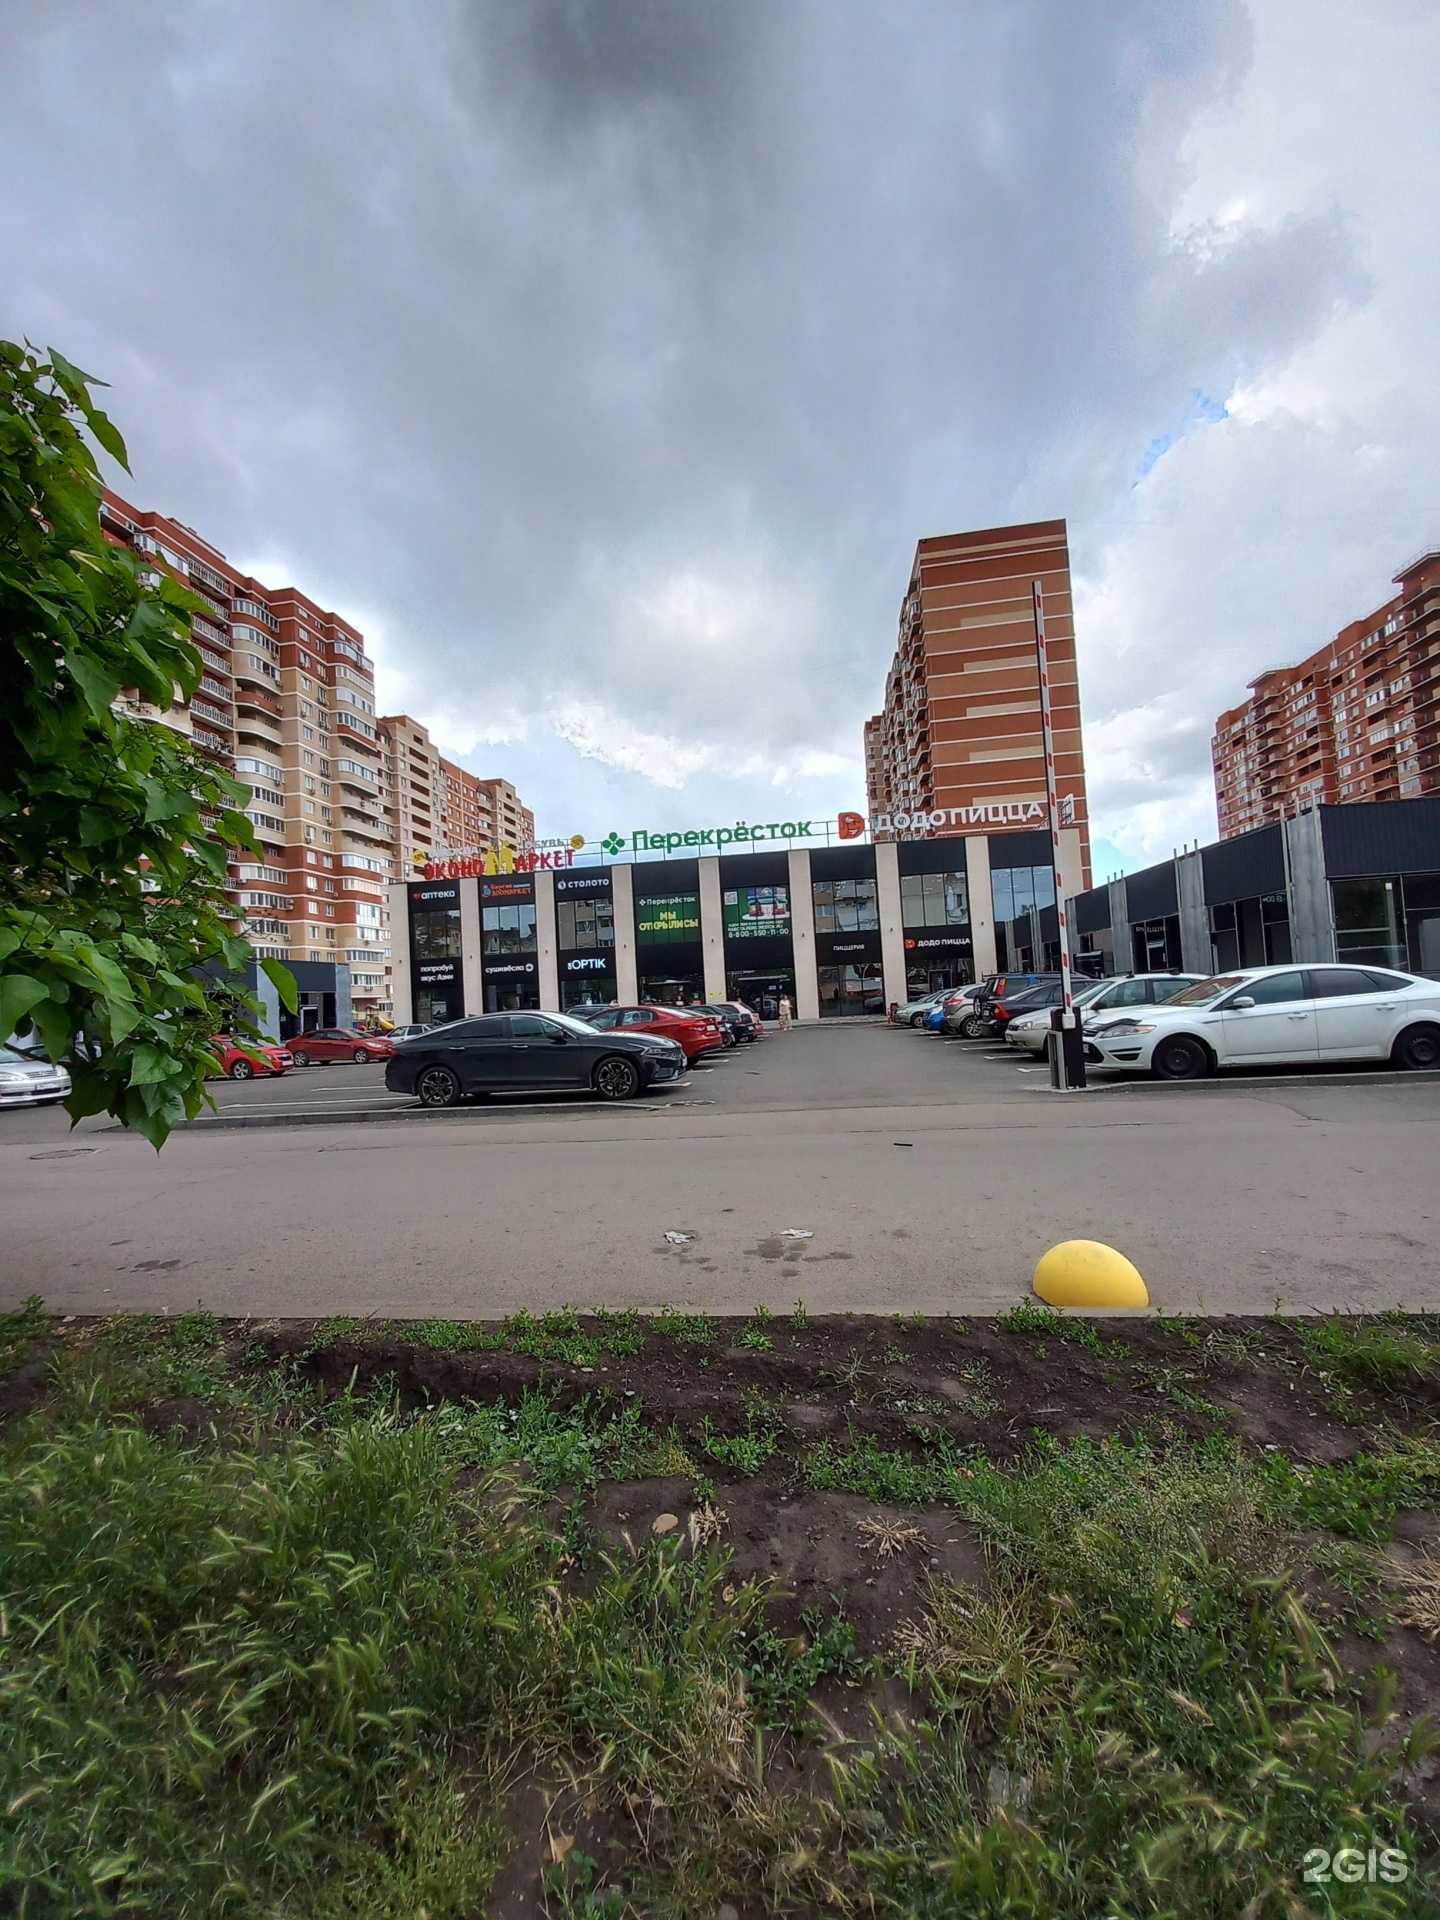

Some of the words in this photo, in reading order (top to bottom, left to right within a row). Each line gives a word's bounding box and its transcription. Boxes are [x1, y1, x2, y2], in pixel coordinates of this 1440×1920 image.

[873, 810, 946, 833] ДОДО
[950, 801, 1044, 825] ПИЦЦА
[632, 821, 812, 853] Перекрёсток
[659, 911, 677, 920] МЫ
